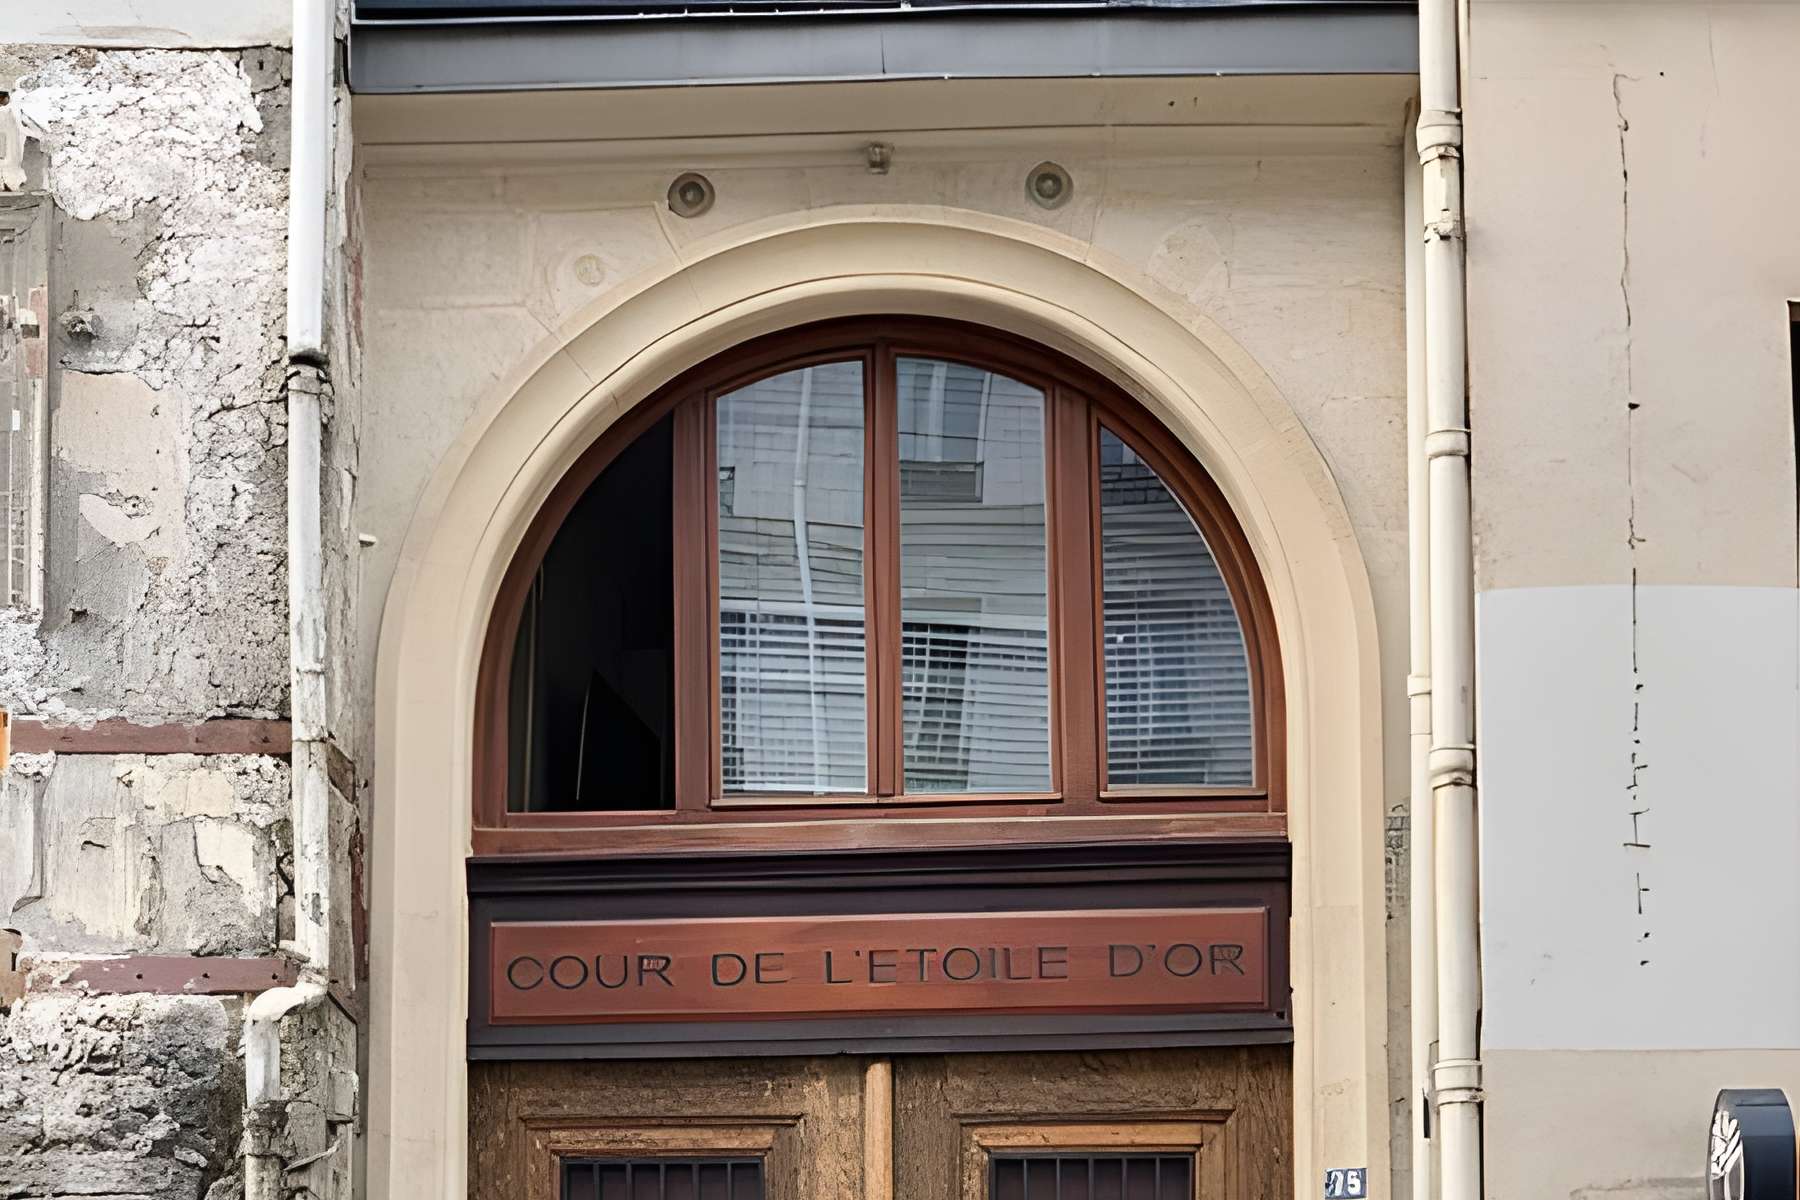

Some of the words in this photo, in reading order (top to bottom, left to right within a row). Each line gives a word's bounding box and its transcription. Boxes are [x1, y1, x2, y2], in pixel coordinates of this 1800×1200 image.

[507, 953, 674, 990] COUR
[711, 951, 790, 986] DE
[824, 944, 1069, 985] L'ETOILE
[1108, 943, 1245, 978] D'OR
